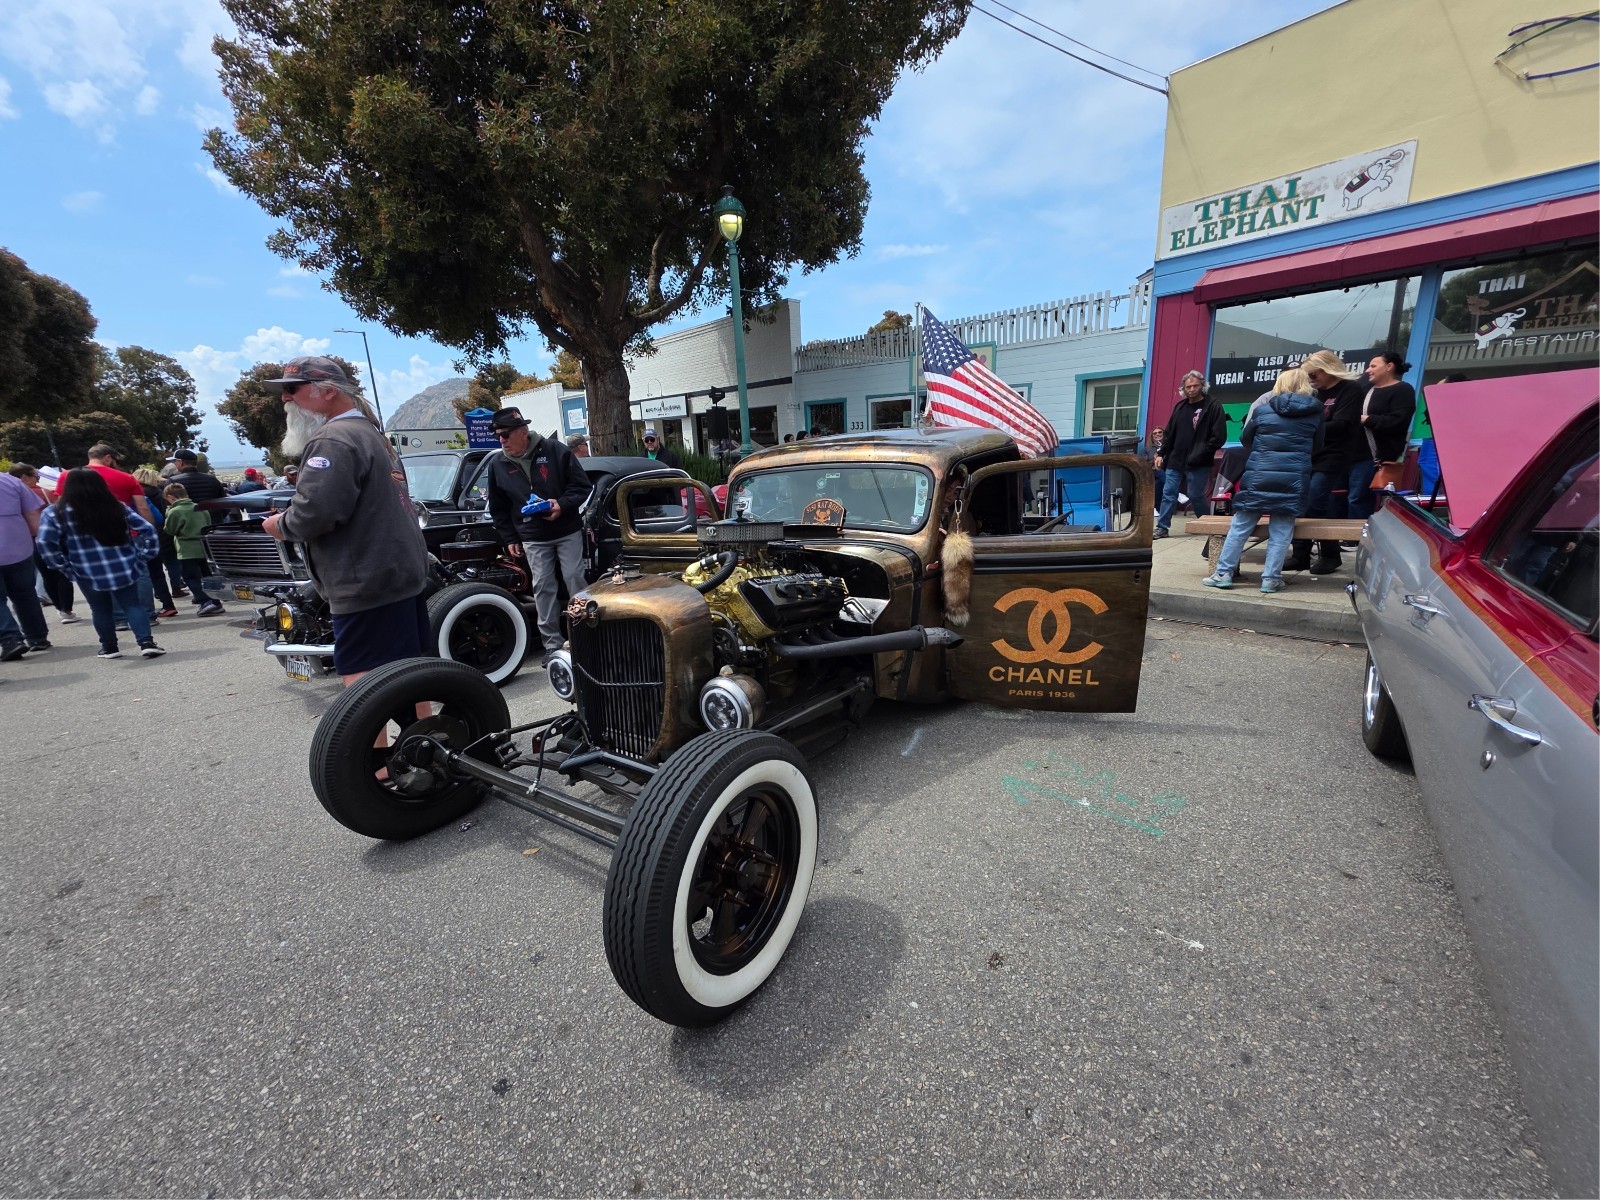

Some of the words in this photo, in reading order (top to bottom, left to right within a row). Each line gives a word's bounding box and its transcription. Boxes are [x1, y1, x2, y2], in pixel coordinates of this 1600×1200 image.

[1194, 176, 1302, 223] THAI
[1170, 194, 1325, 251] ELEPHANT
[1479, 274, 1526, 294] THAI
[1257, 355, 1283, 367] ALSO
[1287, 350, 1345, 364] AVALE
[1215, 372, 1244, 385] VEGAN
[850, 421, 864, 431] 333
[988, 666, 1099, 686] CHANEL
[1008, 689, 1044, 697] PARIS
[1048, 690, 1076, 698] 1936
